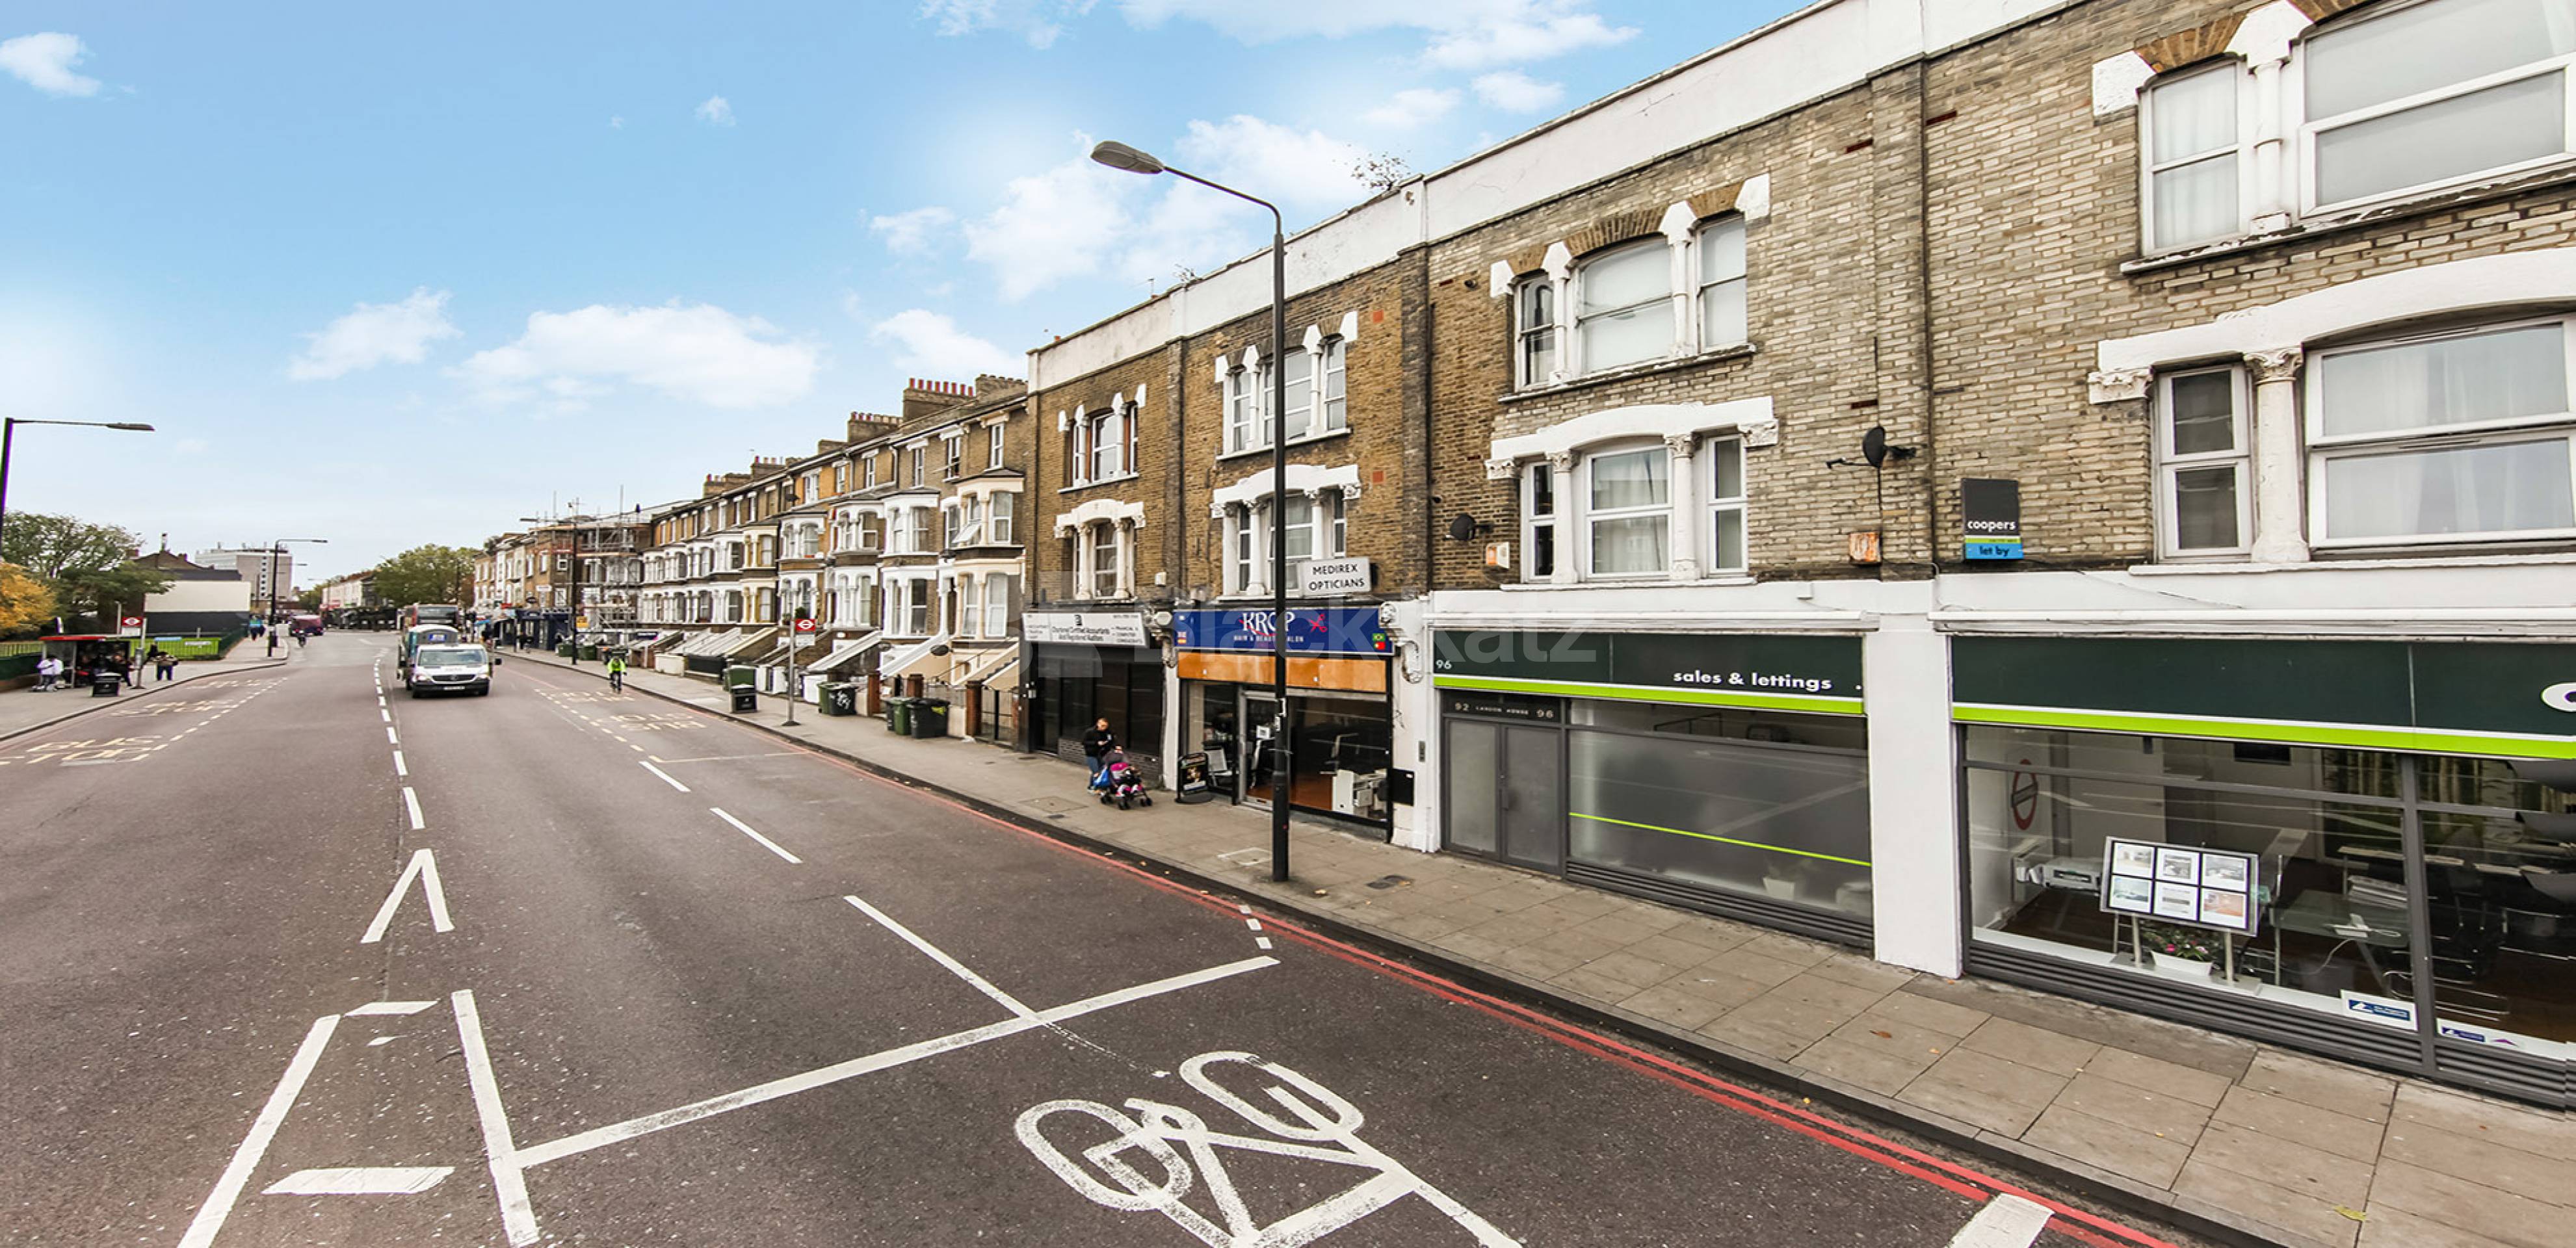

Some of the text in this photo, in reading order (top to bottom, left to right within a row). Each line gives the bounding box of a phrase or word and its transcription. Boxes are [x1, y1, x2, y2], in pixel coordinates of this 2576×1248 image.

[1967, 521, 2016, 532] coopers
[1979, 545, 2010, 557] let by
[1312, 564, 1358, 575] MEDIREX
[1309, 577, 1365, 591] OPTICIANS
[1436, 659, 1452, 670] 96
[1674, 670, 1832, 692] sales & lettings
